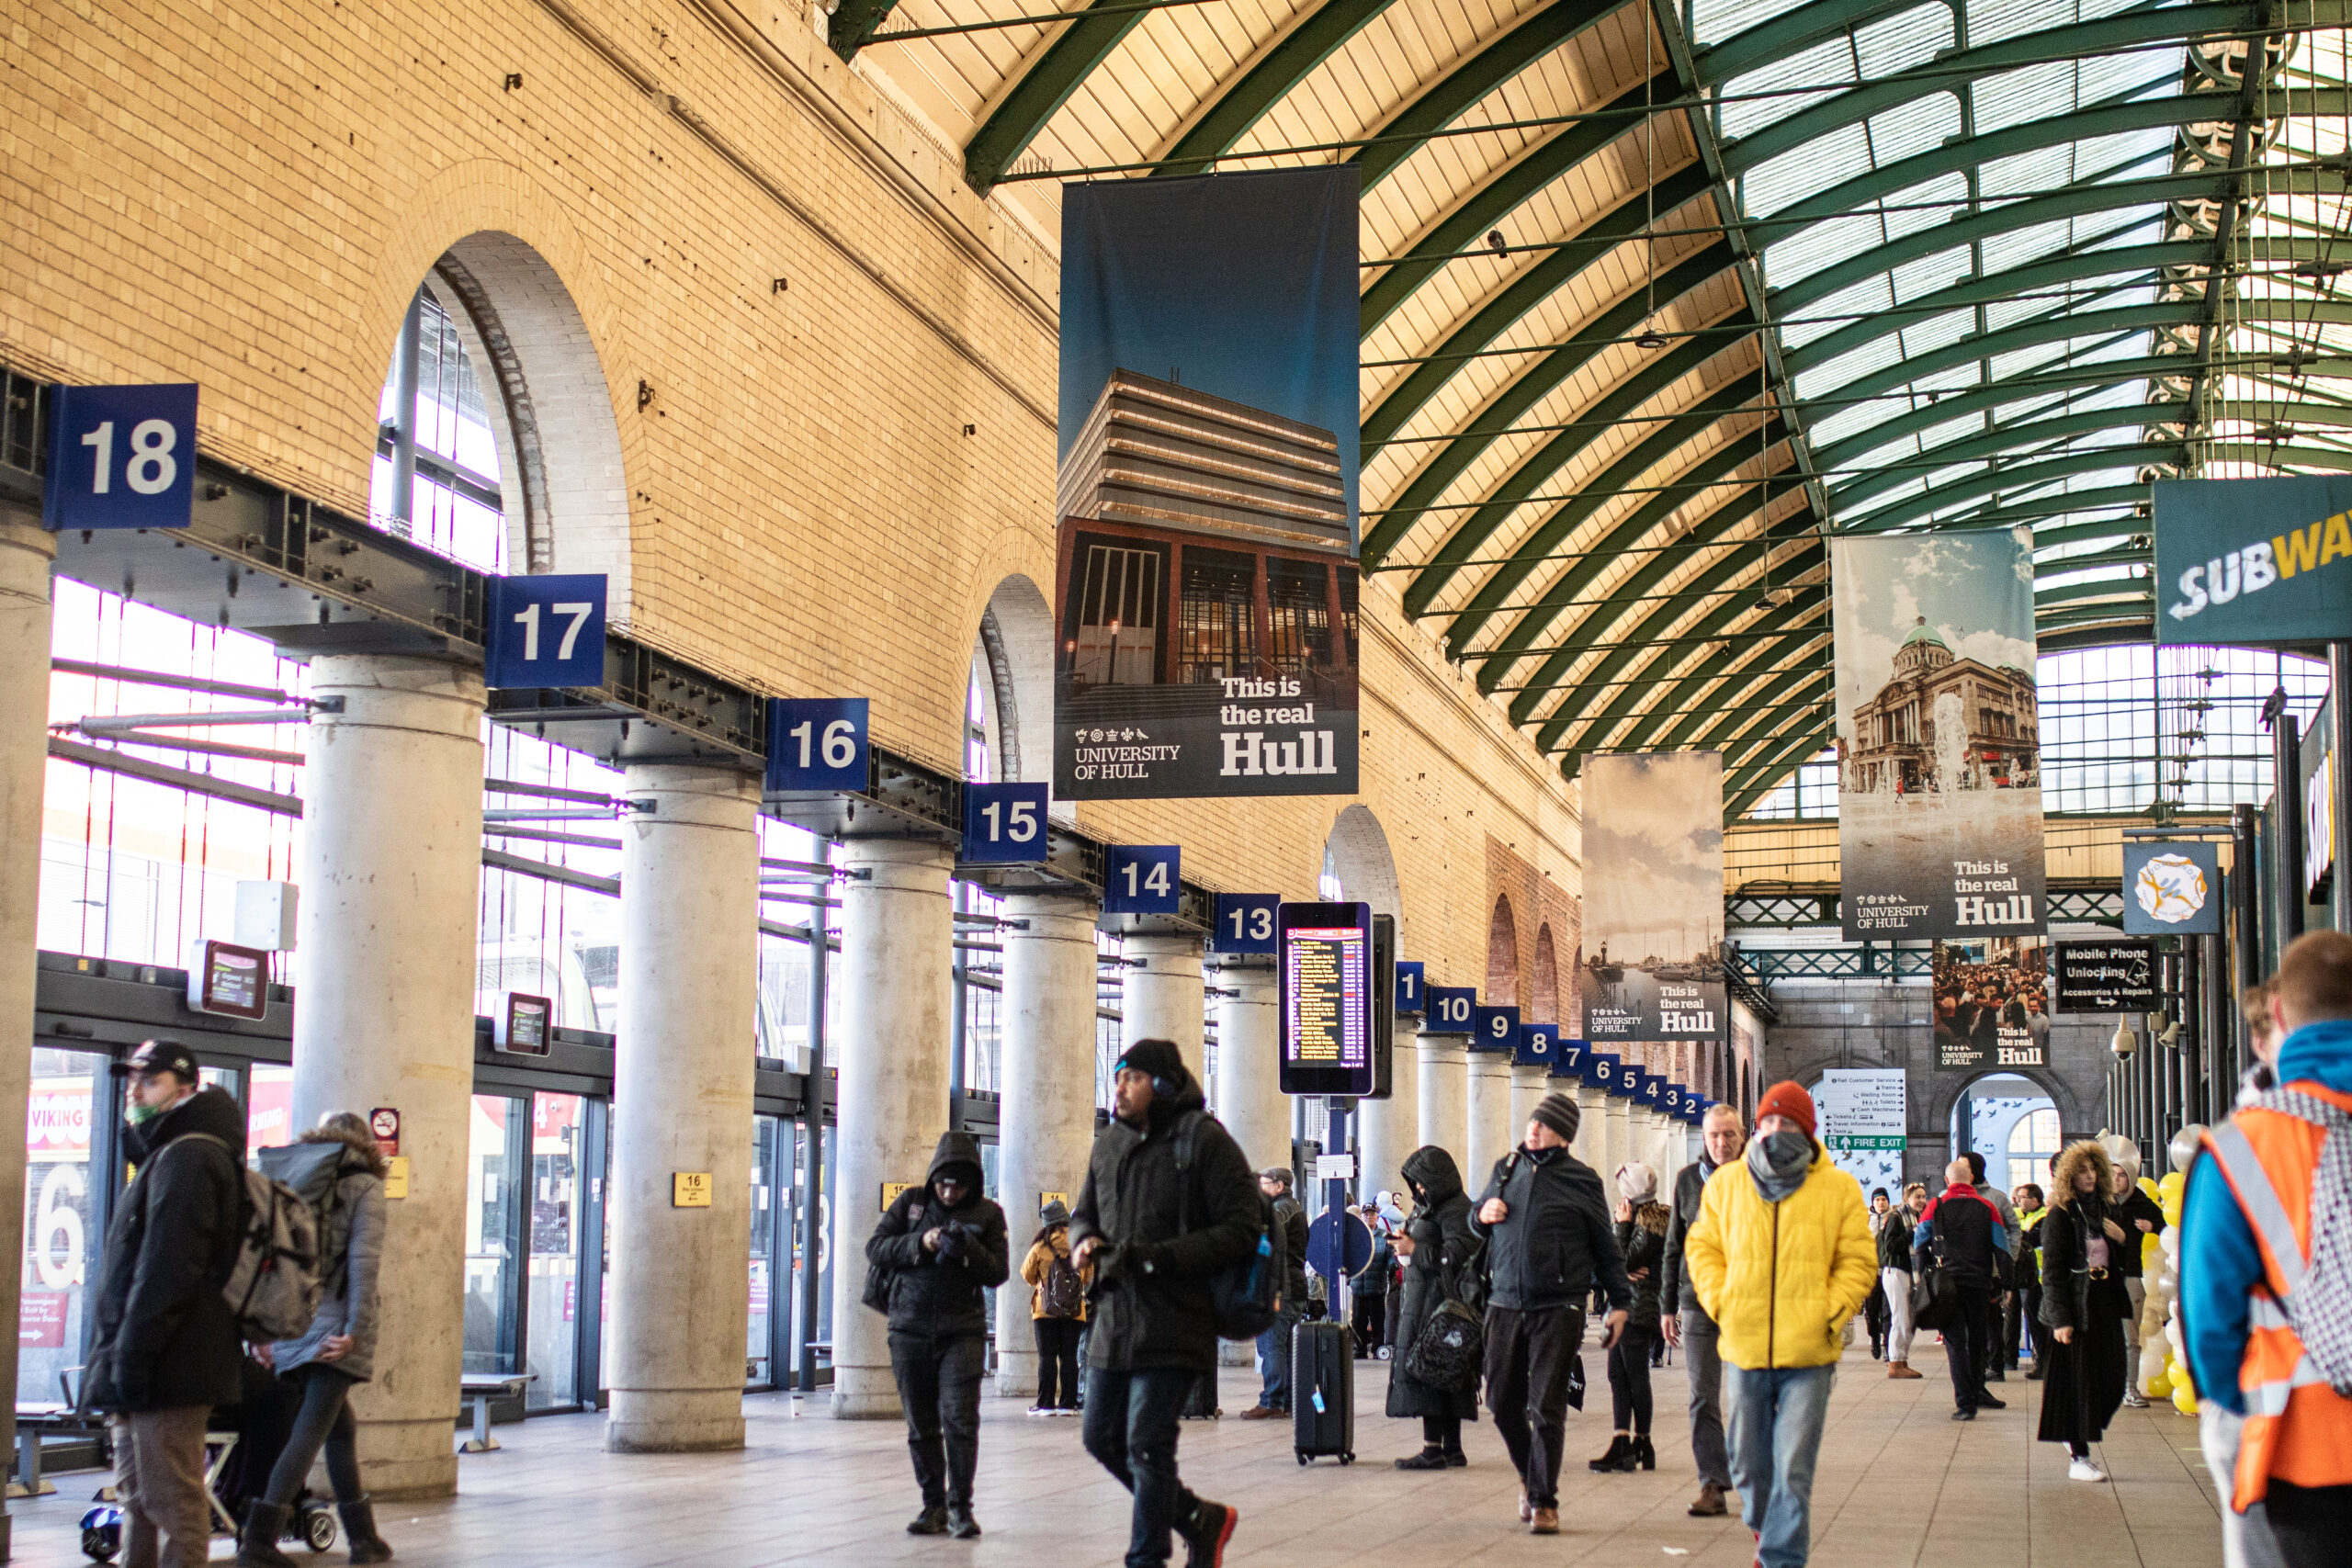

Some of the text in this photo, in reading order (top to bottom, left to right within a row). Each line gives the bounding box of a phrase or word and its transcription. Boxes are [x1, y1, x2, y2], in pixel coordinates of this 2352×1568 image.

[81, 420, 177, 494] 18
[2168, 508, 2352, 621] SUBWA
[514, 602, 592, 660] 17
[1221, 677, 1301, 698] This is
[1221, 703, 1314, 725] the real
[790, 720, 856, 769] 16
[1075, 745, 1181, 762] UNIVERSITY
[1220, 731, 1337, 776] Hull
[1075, 763, 1149, 780] OF HULL
[981, 802, 1037, 842] 15
[2305, 750, 2335, 896] SUB
[1954, 860, 2008, 875] This is
[1121, 862, 1170, 897] 14
[1955, 877, 2018, 893] the real
[1857, 906, 1928, 918] UNIVERSITY
[1955, 895, 2034, 926] Hull
[1229, 908, 1272, 940] 13
[1857, 918, 1908, 929] OF HULL
[2066, 948, 2148, 959] Mobile Phone
[2067, 966, 2126, 979] Unlocking
[1402, 973, 1413, 998] 1
[1660, 986, 1697, 996] This is
[2122, 988, 2153, 997] Repairs
[1438, 998, 1470, 1021] 10
[1660, 998, 1704, 1009] the real
[1492, 1015, 1508, 1038] 9
[1660, 1011, 1715, 1032] Hull
[1997, 1027, 2028, 1036] This is
[1532, 1033, 1547, 1054] 8
[2014, 1038, 2033, 1046] real
[1567, 1048, 1580, 1066] 7
[1997, 1048, 2043, 1065] Hull
[1597, 1061, 1610, 1079] 6
[1623, 1072, 1636, 1088] 5
[1646, 1082, 1658, 1097] 4
[1667, 1090, 1678, 1105] 3
[1685, 1099, 1696, 1113] 2
[33, 1109, 83, 1127] VIKING
[1854, 1138, 1902, 1147] FIRE EXIT
[688, 1175, 700, 1186] 16
[36, 1164, 85, 1291] 6
